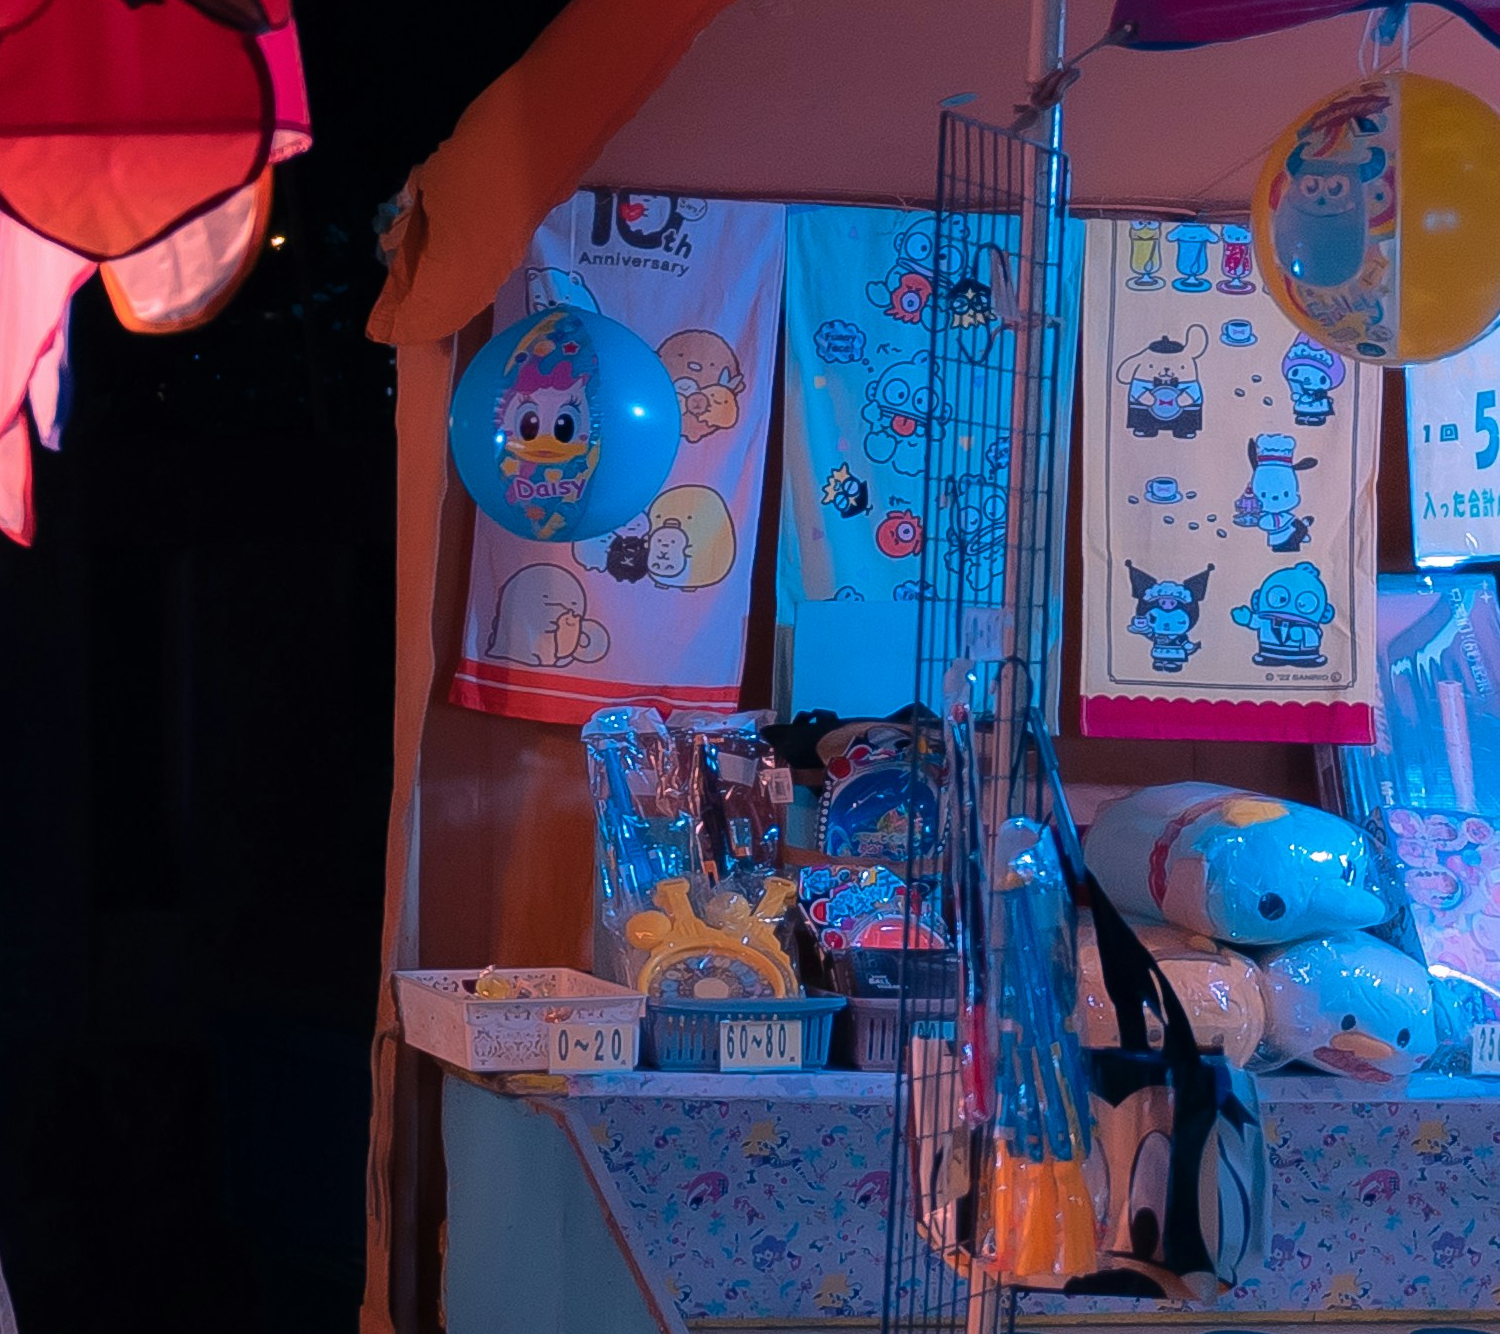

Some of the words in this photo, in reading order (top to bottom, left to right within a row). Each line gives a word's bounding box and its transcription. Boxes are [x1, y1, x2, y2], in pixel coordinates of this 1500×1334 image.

[578, 251, 690, 277] Anniversary
[1423, 423, 1459, 443] 1回
[517, 478, 586, 499] Daisy
[1423, 488, 1500, 519] 入った合計
[1479, 1026, 1500, 1062] 25
